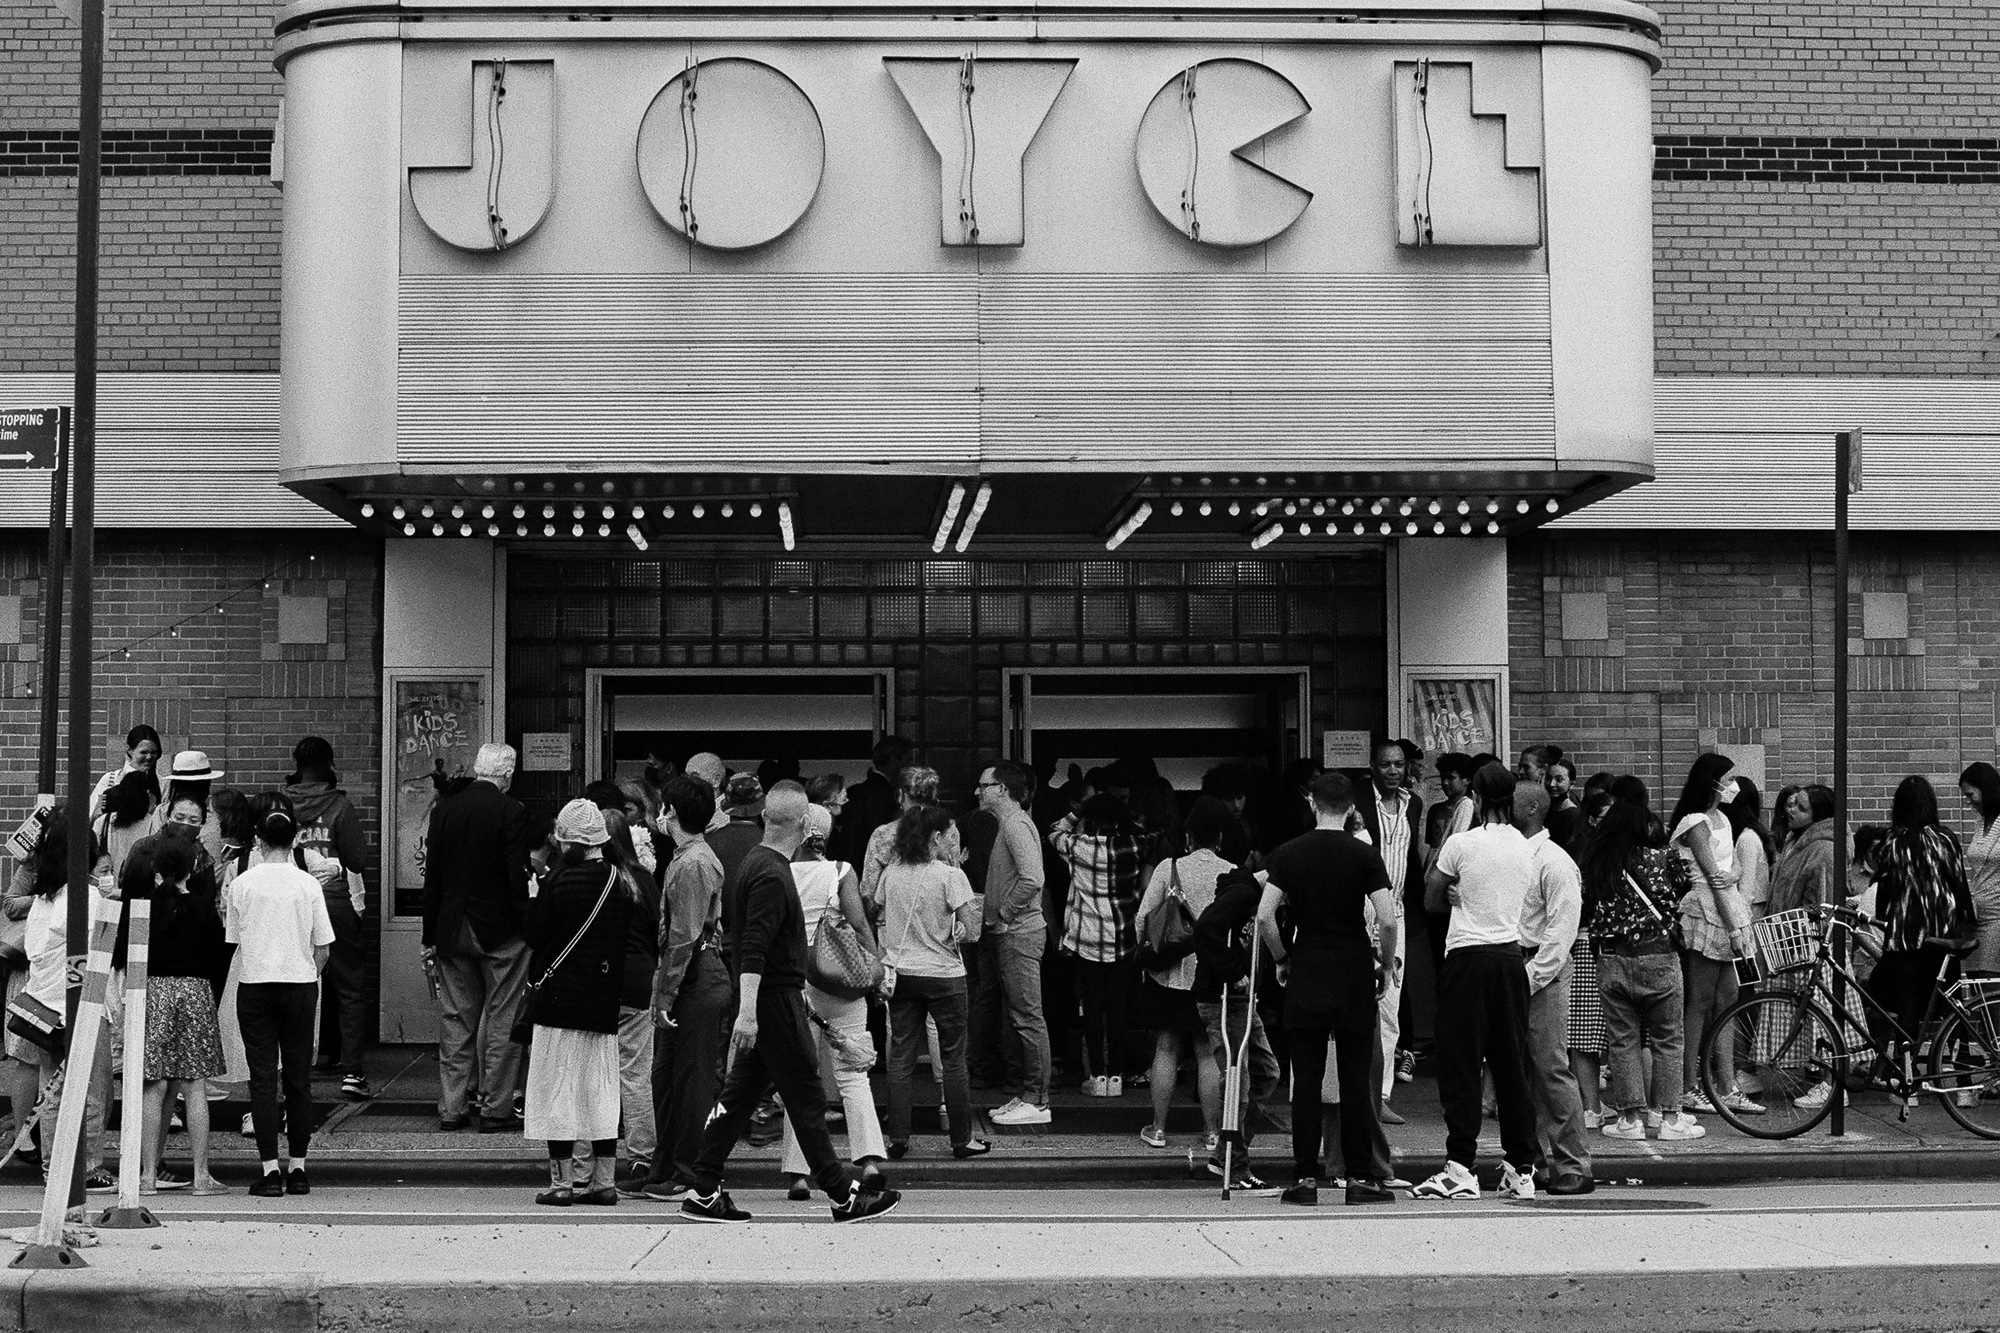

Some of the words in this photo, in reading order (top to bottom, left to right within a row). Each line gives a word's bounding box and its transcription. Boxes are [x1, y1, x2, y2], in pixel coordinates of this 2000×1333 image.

[408, 57, 1542, 252] JOYCE
[0, 414, 44, 426] TOPPING
[0, 429, 19, 440] ime
[405, 730, 470, 757] DANCE
[1424, 728, 1486, 754] DANCE
